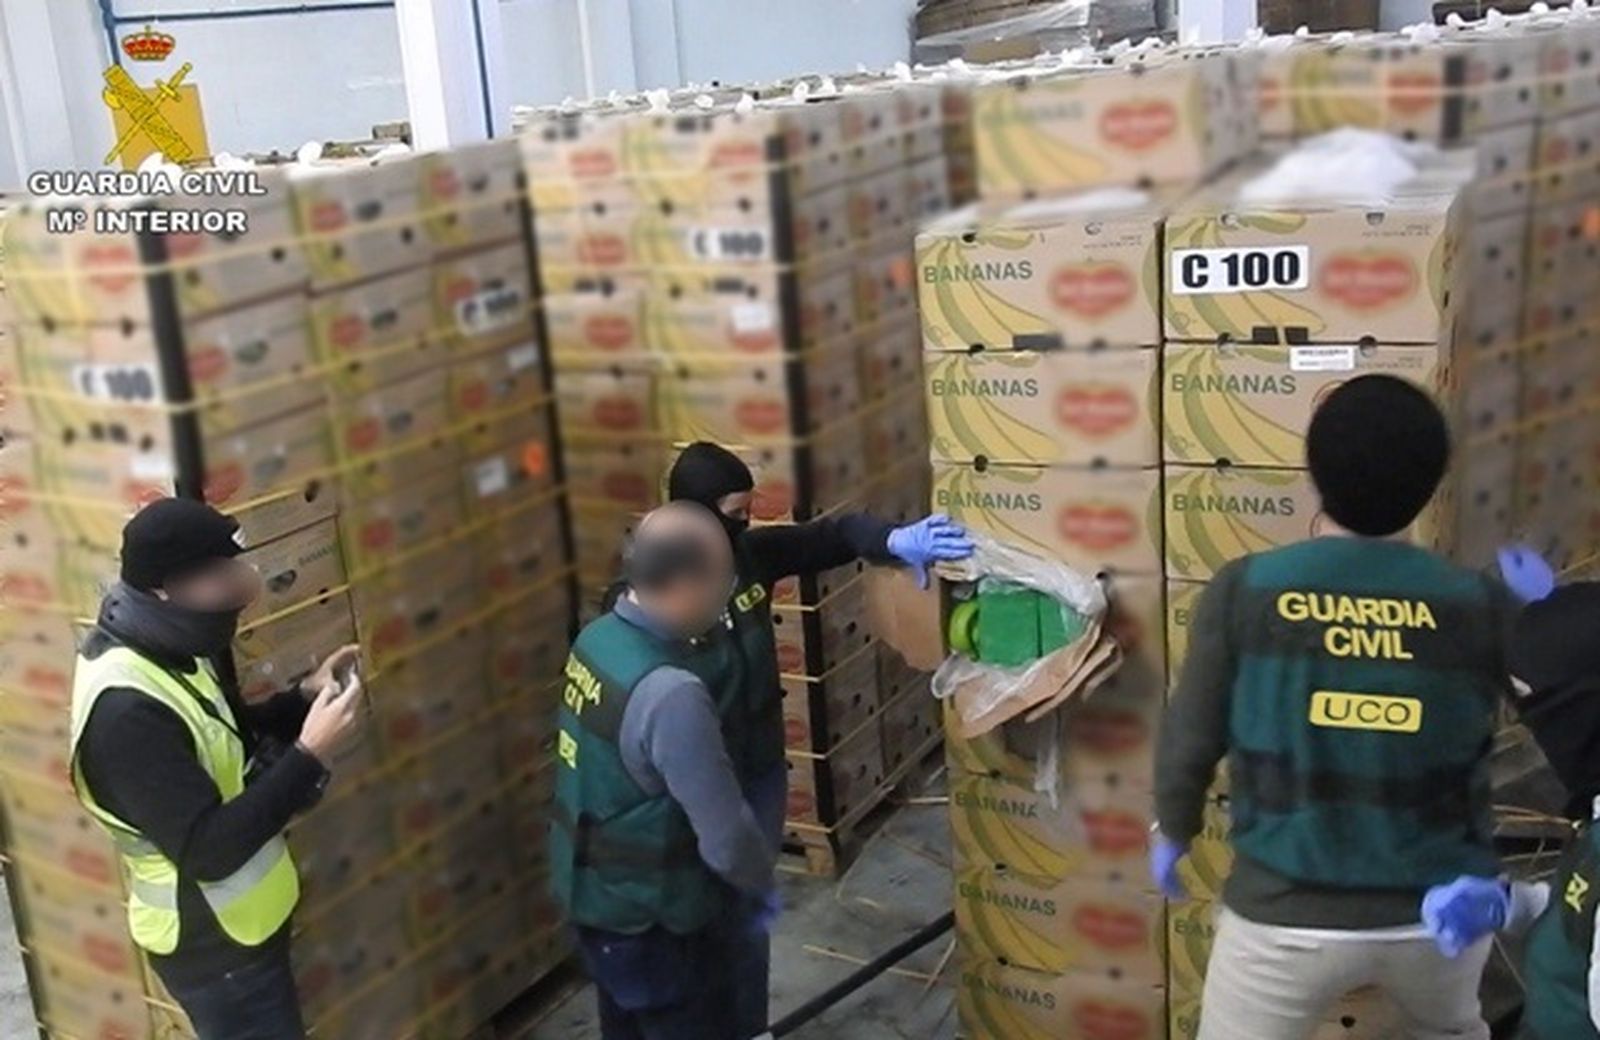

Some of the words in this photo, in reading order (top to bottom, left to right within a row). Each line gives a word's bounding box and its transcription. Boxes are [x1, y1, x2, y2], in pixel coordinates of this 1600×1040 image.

[924, 261, 1033, 284] BANANAS
[1182, 254, 1209, 288] C
[1221, 250, 1300, 287] 100
[931, 378, 1039, 397] BANANAS
[1172, 374, 1297, 395] BANANAS
[937, 489, 1042, 511] BANANAS
[1172, 494, 1295, 516] BANANAS
[1277, 591, 1437, 629] GUARDIA
[1324, 626, 1413, 660] CIVIL
[1324, 697, 1412, 726] UCO
[959, 882, 1056, 916] BANANAS
